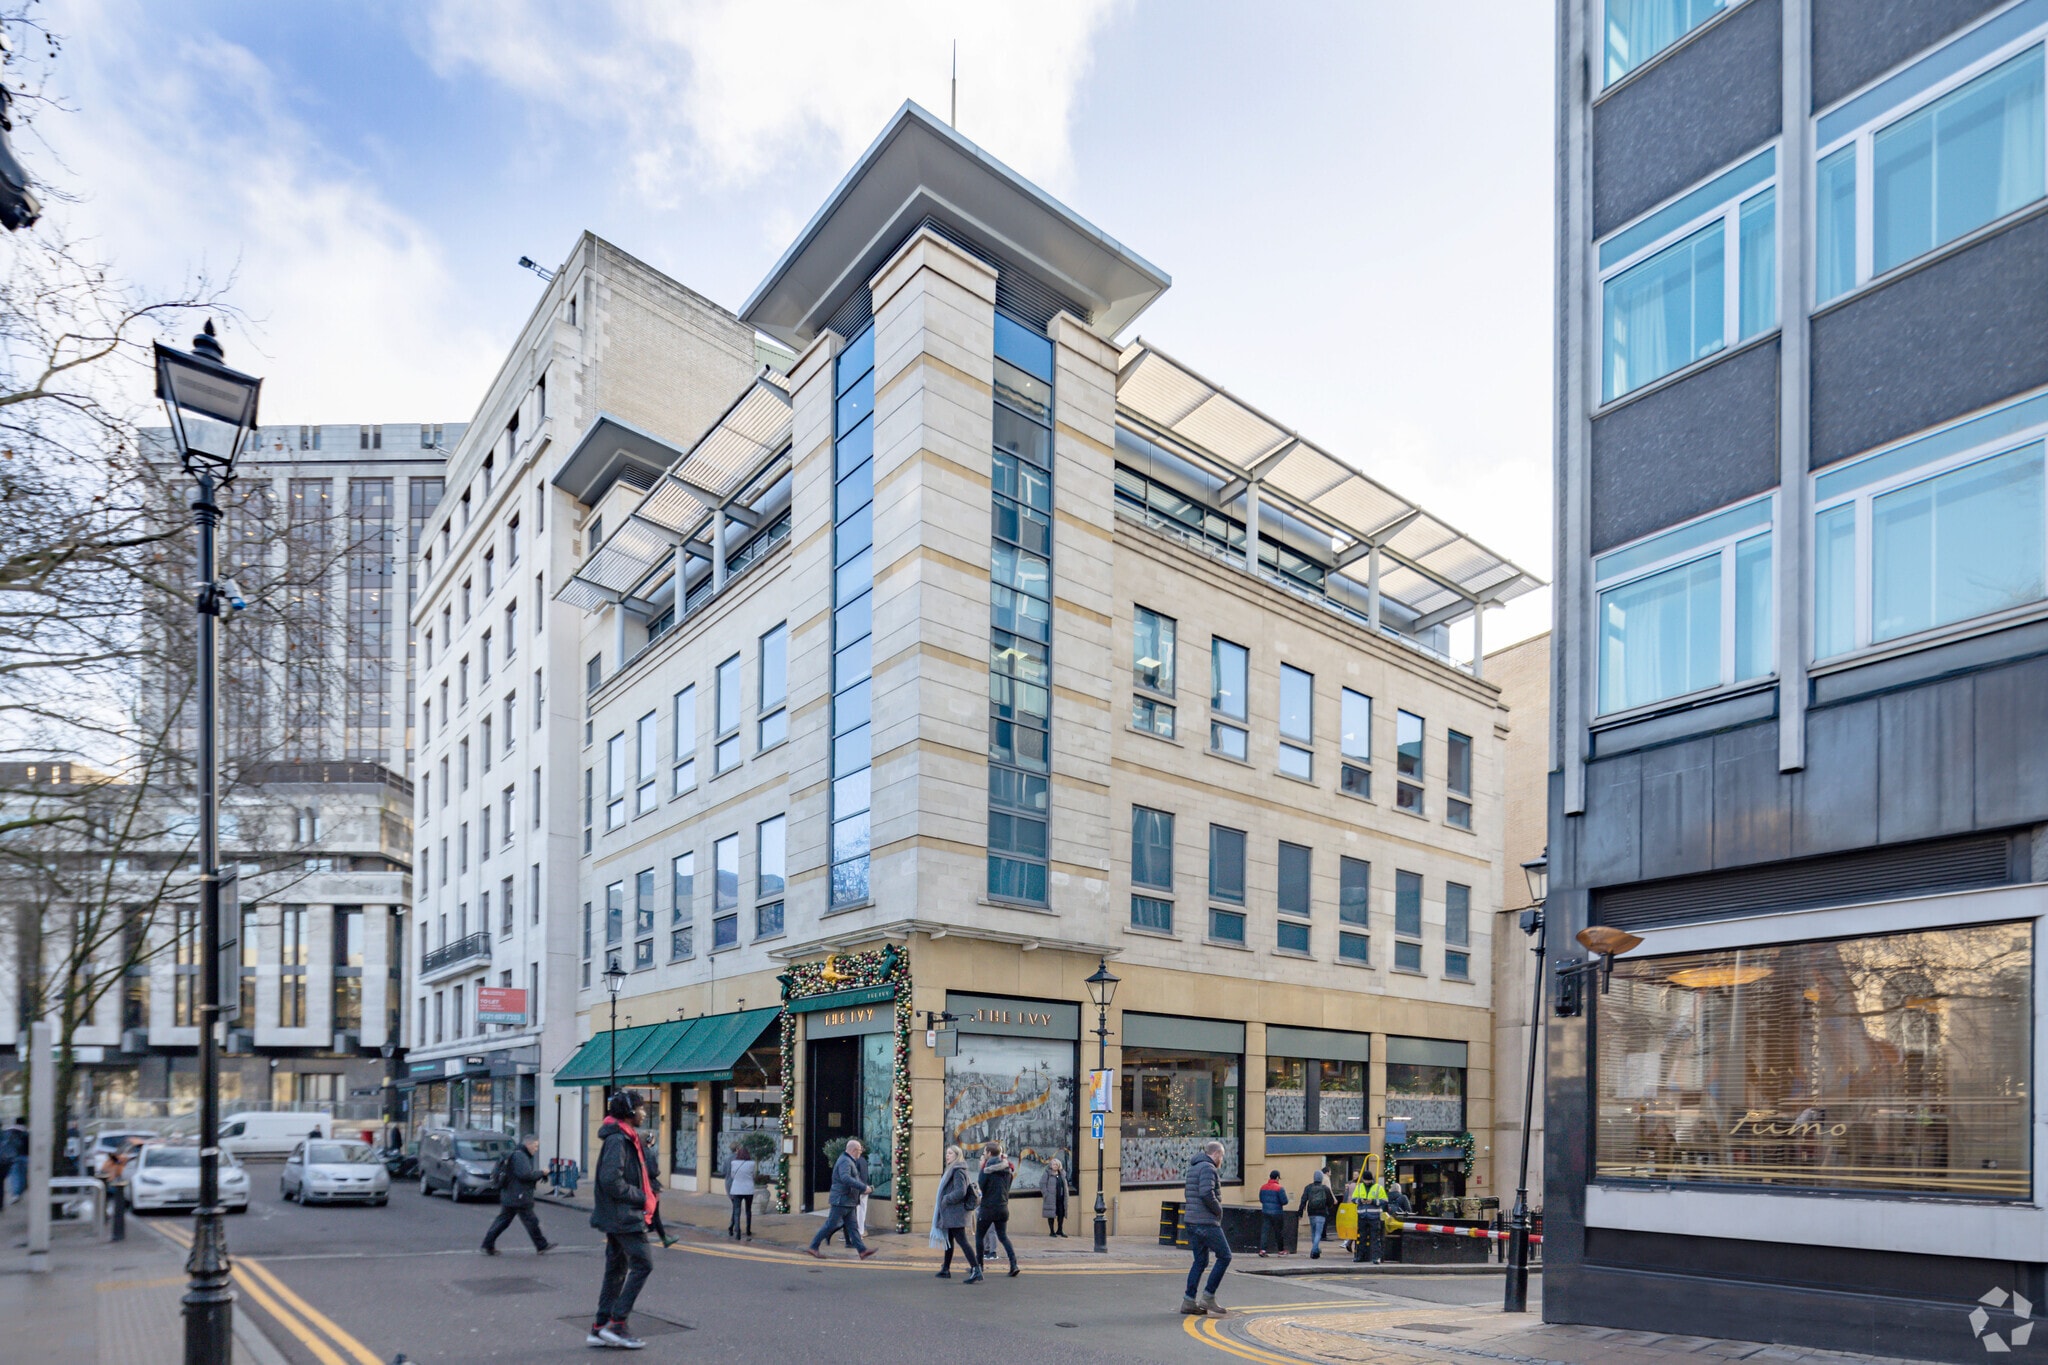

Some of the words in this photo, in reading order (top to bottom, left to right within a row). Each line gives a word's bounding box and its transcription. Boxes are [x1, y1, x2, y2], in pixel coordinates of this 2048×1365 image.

[825, 1011, 845, 1026] THE
[850, 1009, 873, 1023] IVY
[977, 1008, 1010, 1024] THE
[1019, 1012, 1052, 1026] IVY
[1729, 1109, 1848, 1137] Fumo
